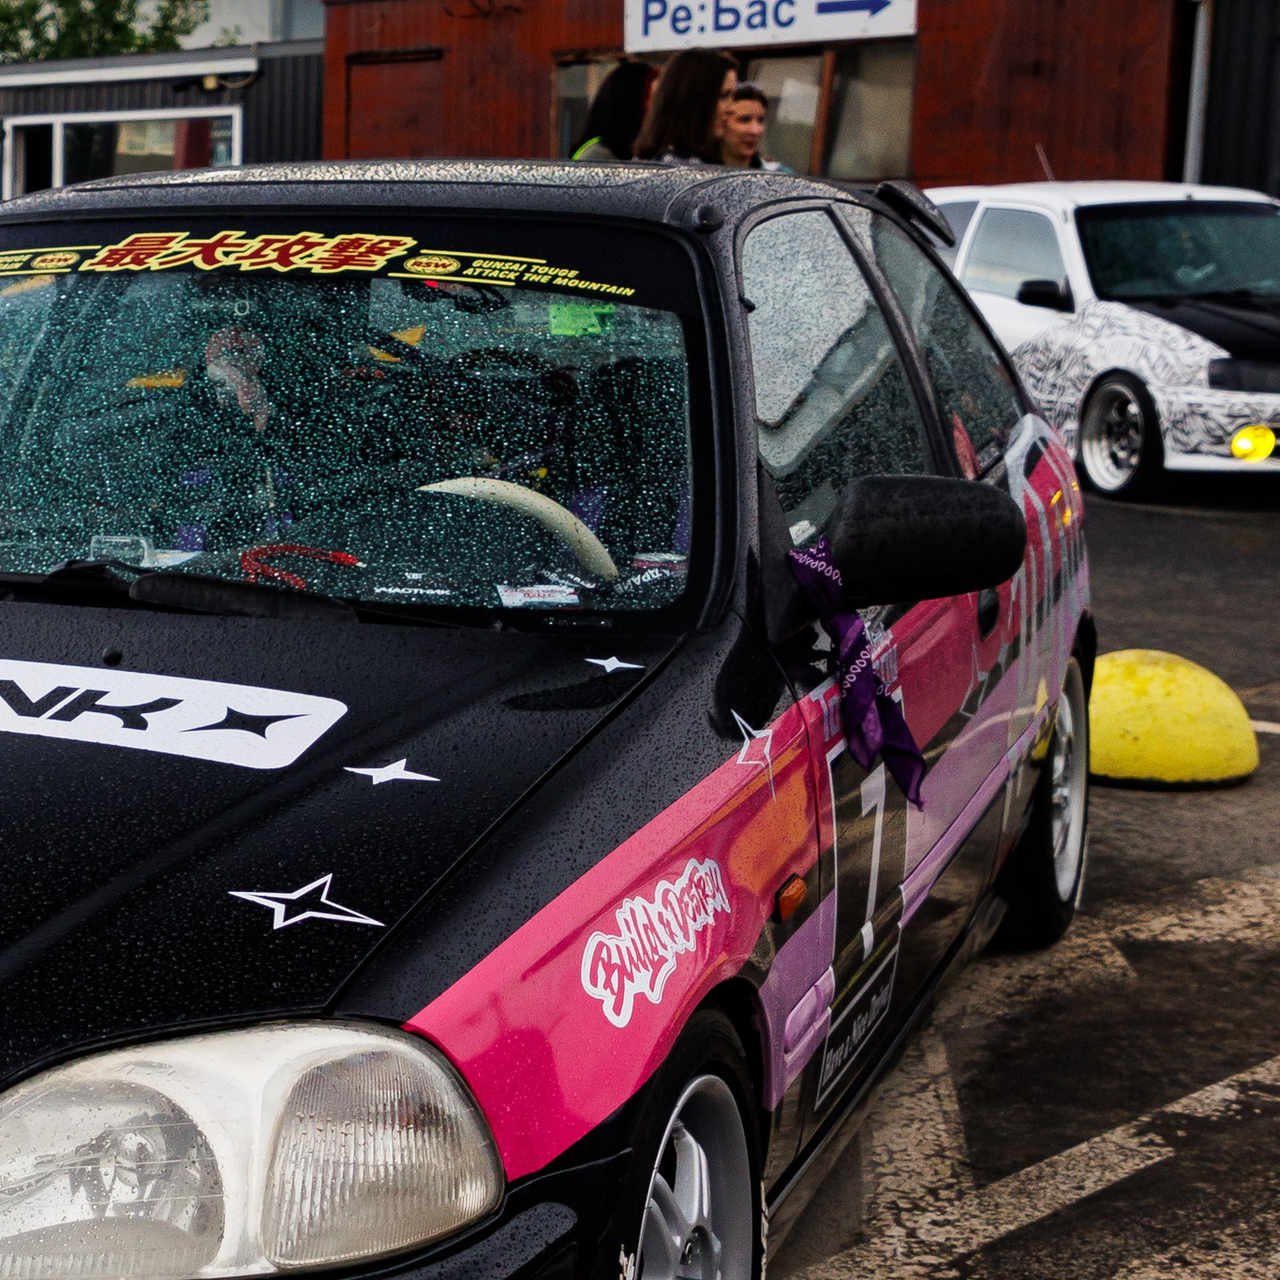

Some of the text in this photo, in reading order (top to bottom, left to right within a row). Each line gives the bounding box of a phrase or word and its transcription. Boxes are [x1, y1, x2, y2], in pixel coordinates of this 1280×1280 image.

[471, 259, 579, 278] GUNSAI TOUGE
[463, 268, 636, 297] ATTACK THE MOUNTAIN
